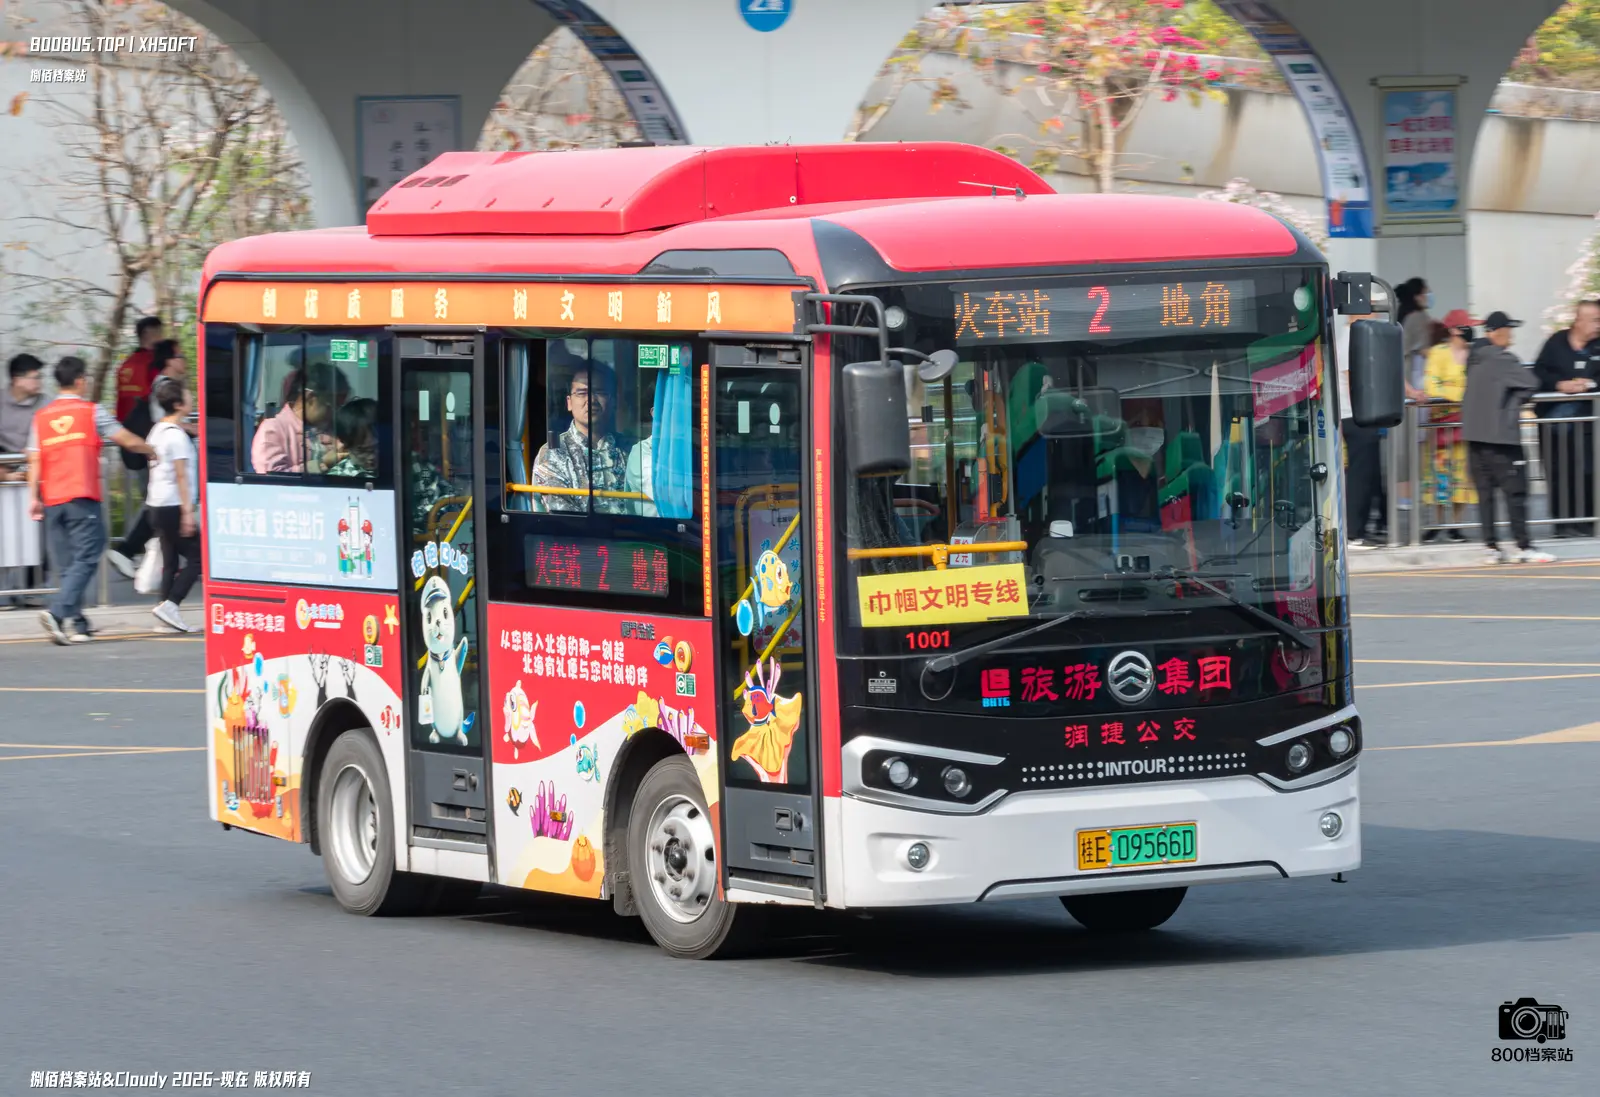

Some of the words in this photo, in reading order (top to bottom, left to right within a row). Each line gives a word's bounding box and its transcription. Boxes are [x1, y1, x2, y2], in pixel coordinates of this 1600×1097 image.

[513, 289, 722, 323] 树文明新风
[954, 288, 1050, 339] 火车站
[1087, 286, 1111, 333] 2
[1160, 282, 1231, 327] 地角
[535, 541, 581, 588] 火车站
[597, 545, 610, 590] 2
[632, 548, 668, 595] 地角
[868, 579, 1020, 615] 巾帼文明专线
[500, 629, 625, 663] 从您踏入北海的那一刻起
[906, 631, 950, 649] 1001
[522, 653, 649, 688] 北海有礼便与您时刻相伴
[1020, 662, 1102, 702] 旅游
[1157, 655, 1232, 695] 集团
[1064, 717, 1197, 748] 润捷公交
[1105, 758, 1167, 776] INTOUR
[1117, 829, 1195, 862] 09566D
